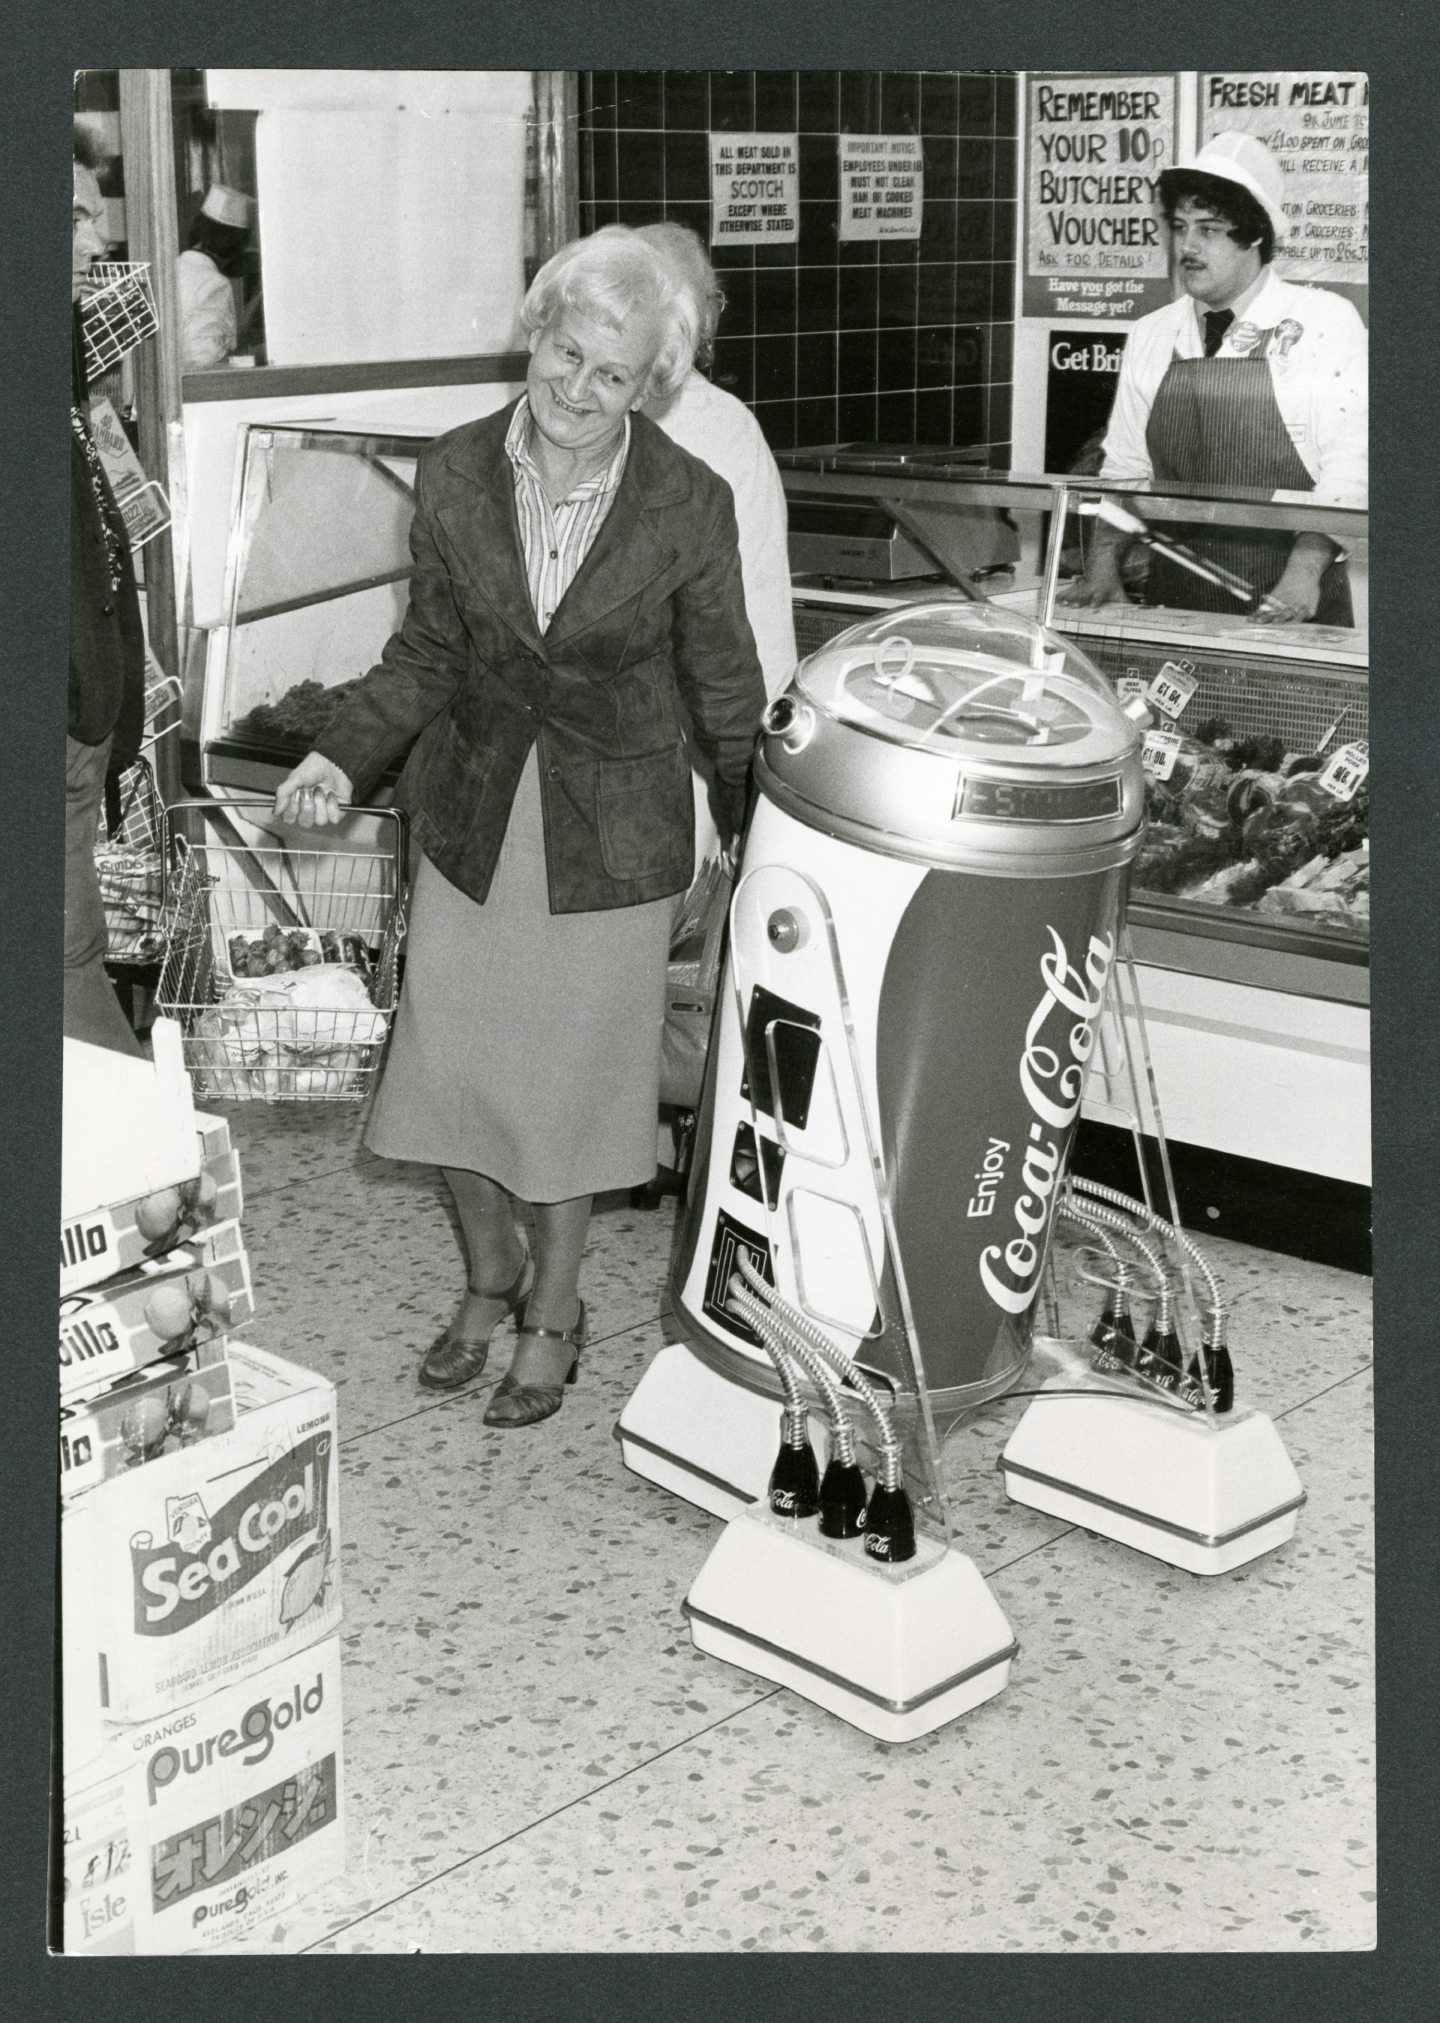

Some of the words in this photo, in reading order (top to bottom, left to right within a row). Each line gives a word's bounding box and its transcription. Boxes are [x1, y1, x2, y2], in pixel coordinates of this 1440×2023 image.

[1209, 77, 1280, 107] FRESH
[1288, 81, 1356, 106] MEAT
[1038, 85, 1161, 122] REMEMBER
[1321, 110, 1350, 127] JUNE
[847, 142, 887, 154] IMPORTANT
[891, 142, 916, 154] NOTICE
[1039, 133, 1107, 163] YOUR
[1119, 127, 1164, 169] 10p
[1301, 136, 1331, 150] SPENT
[1332, 137, 1346, 149] ON
[1350, 135, 1369, 150] GRO
[720, 147, 734, 159] ALL
[737, 146, 758, 159] MEAT
[761, 146, 780, 158] SOLD
[783, 146, 791, 158] IN
[715, 163, 733, 176] THIS
[736, 162, 785, 175] DEPARTMENT
[788, 162, 796, 175] IS
[843, 160, 886, 172] EMPLOYEES
[888, 160, 912, 172] UNDER
[1302, 159, 1346, 172] RECEIVE
[1349, 159, 1357, 172] A
[731, 180, 784, 199] SCOTCH
[850, 176, 871, 188] MUST
[875, 176, 888, 188] NOT
[892, 176, 914, 188] CLEAN
[1040, 169, 1160, 204] BUTCHERY
[728, 204, 757, 217] EXCEPT
[761, 204, 788, 216] WHERE
[852, 207, 872, 219] MEAT
[876, 207, 913, 219] MACHINES
[719, 220, 762, 233] OTHERWISE
[766, 219, 794, 231] STATED
[1048, 210, 1160, 246] VOUCHER
[1038, 250, 1058, 265] ASK
[1066, 253, 1091, 266] FOR
[1310, 247, 1322, 259] UP
[1323, 247, 1335, 259] TO
[1048, 278, 1079, 292] Have
[1080, 282, 1103, 296] you
[1106, 280, 1123, 297] got
[1125, 280, 1144, 293] the
[1056, 298, 1107, 316] Message
[1109, 300, 1134, 316] yet?
[1052, 342, 1089, 370] Get
[1092, 344, 1122, 372] Bri
[979, 924, 1115, 1315] Coca-Cola
[967, 1137, 1010, 1218] Enjoy
[297, 1412, 330, 1434] LEMONS
[170, 1497, 199, 1518] VENTURA
[155, 1668, 197, 1693] SEABOARD
[200, 1655, 228, 1675] LEMON
[231, 1632, 280, 1661] ASSOCIATION
[132, 1713, 197, 1751] ORANGES
[153, 1775, 327, 1901] オレンジ
